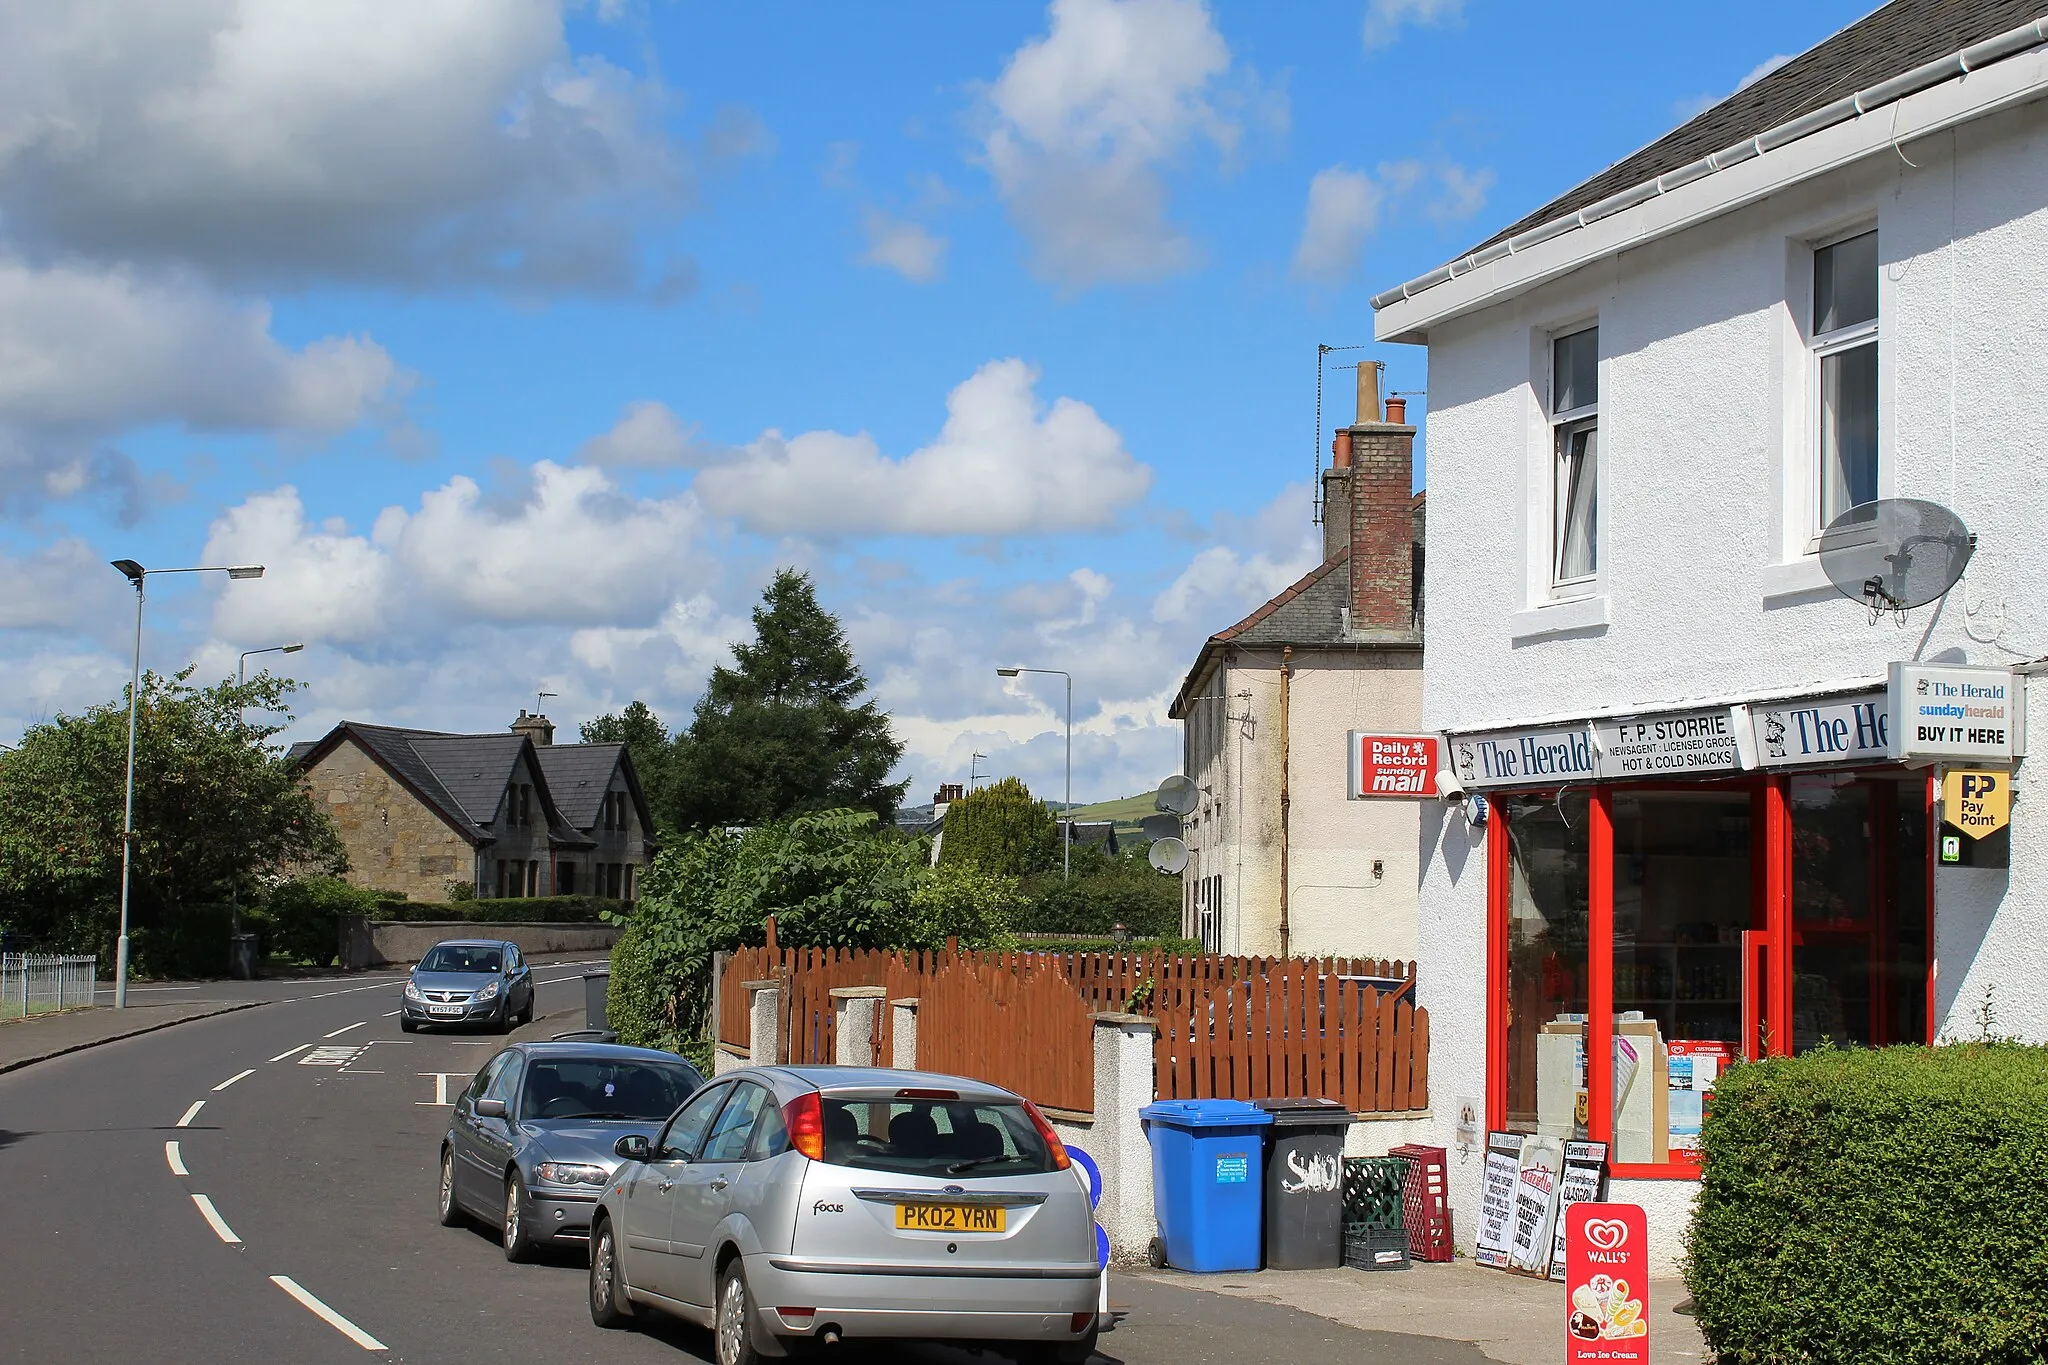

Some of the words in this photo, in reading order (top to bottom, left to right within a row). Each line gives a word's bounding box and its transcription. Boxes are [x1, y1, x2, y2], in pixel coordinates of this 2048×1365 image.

[1932, 682, 1958, 697] The
[1961, 683, 2005, 699] Herald
[1919, 703, 2005, 719] sundayherald
[1655, 715, 1727, 740] STORRIE
[1790, 709, 1849, 755] The
[1918, 725, 1945, 742] BUY
[1950, 727, 1963, 743] IT
[1968, 728, 2005, 744] HERE
[1372, 741, 1410, 756] Daily
[1477, 741, 1518, 779] The
[1518, 731, 1593, 776] Herald
[1609, 743, 1657, 756] NEWSAGENT
[1663, 739, 1704, 752] LICENSED
[1372, 753, 1428, 766] Record
[1622, 758, 1642, 771] HOT
[1646, 757, 1653, 769] &
[1655, 755, 1684, 769] COLD
[1687, 750, 1732, 766] SNACKS
[1372, 769, 1427, 792] mail
[1377, 767, 1417, 777] sunday
[1961, 800, 1984, 815] Pay
[1961, 813, 1995, 826] Point
[904, 1206, 956, 1227] PK02
[961, 1208, 997, 1229] YRN
[1587, 1250, 1627, 1264] WALL'S
[1577, 1350, 1597, 1359] Love
[1597, 1350, 1610, 1359] Ice
[1611, 1350, 1638, 1359] Cream
